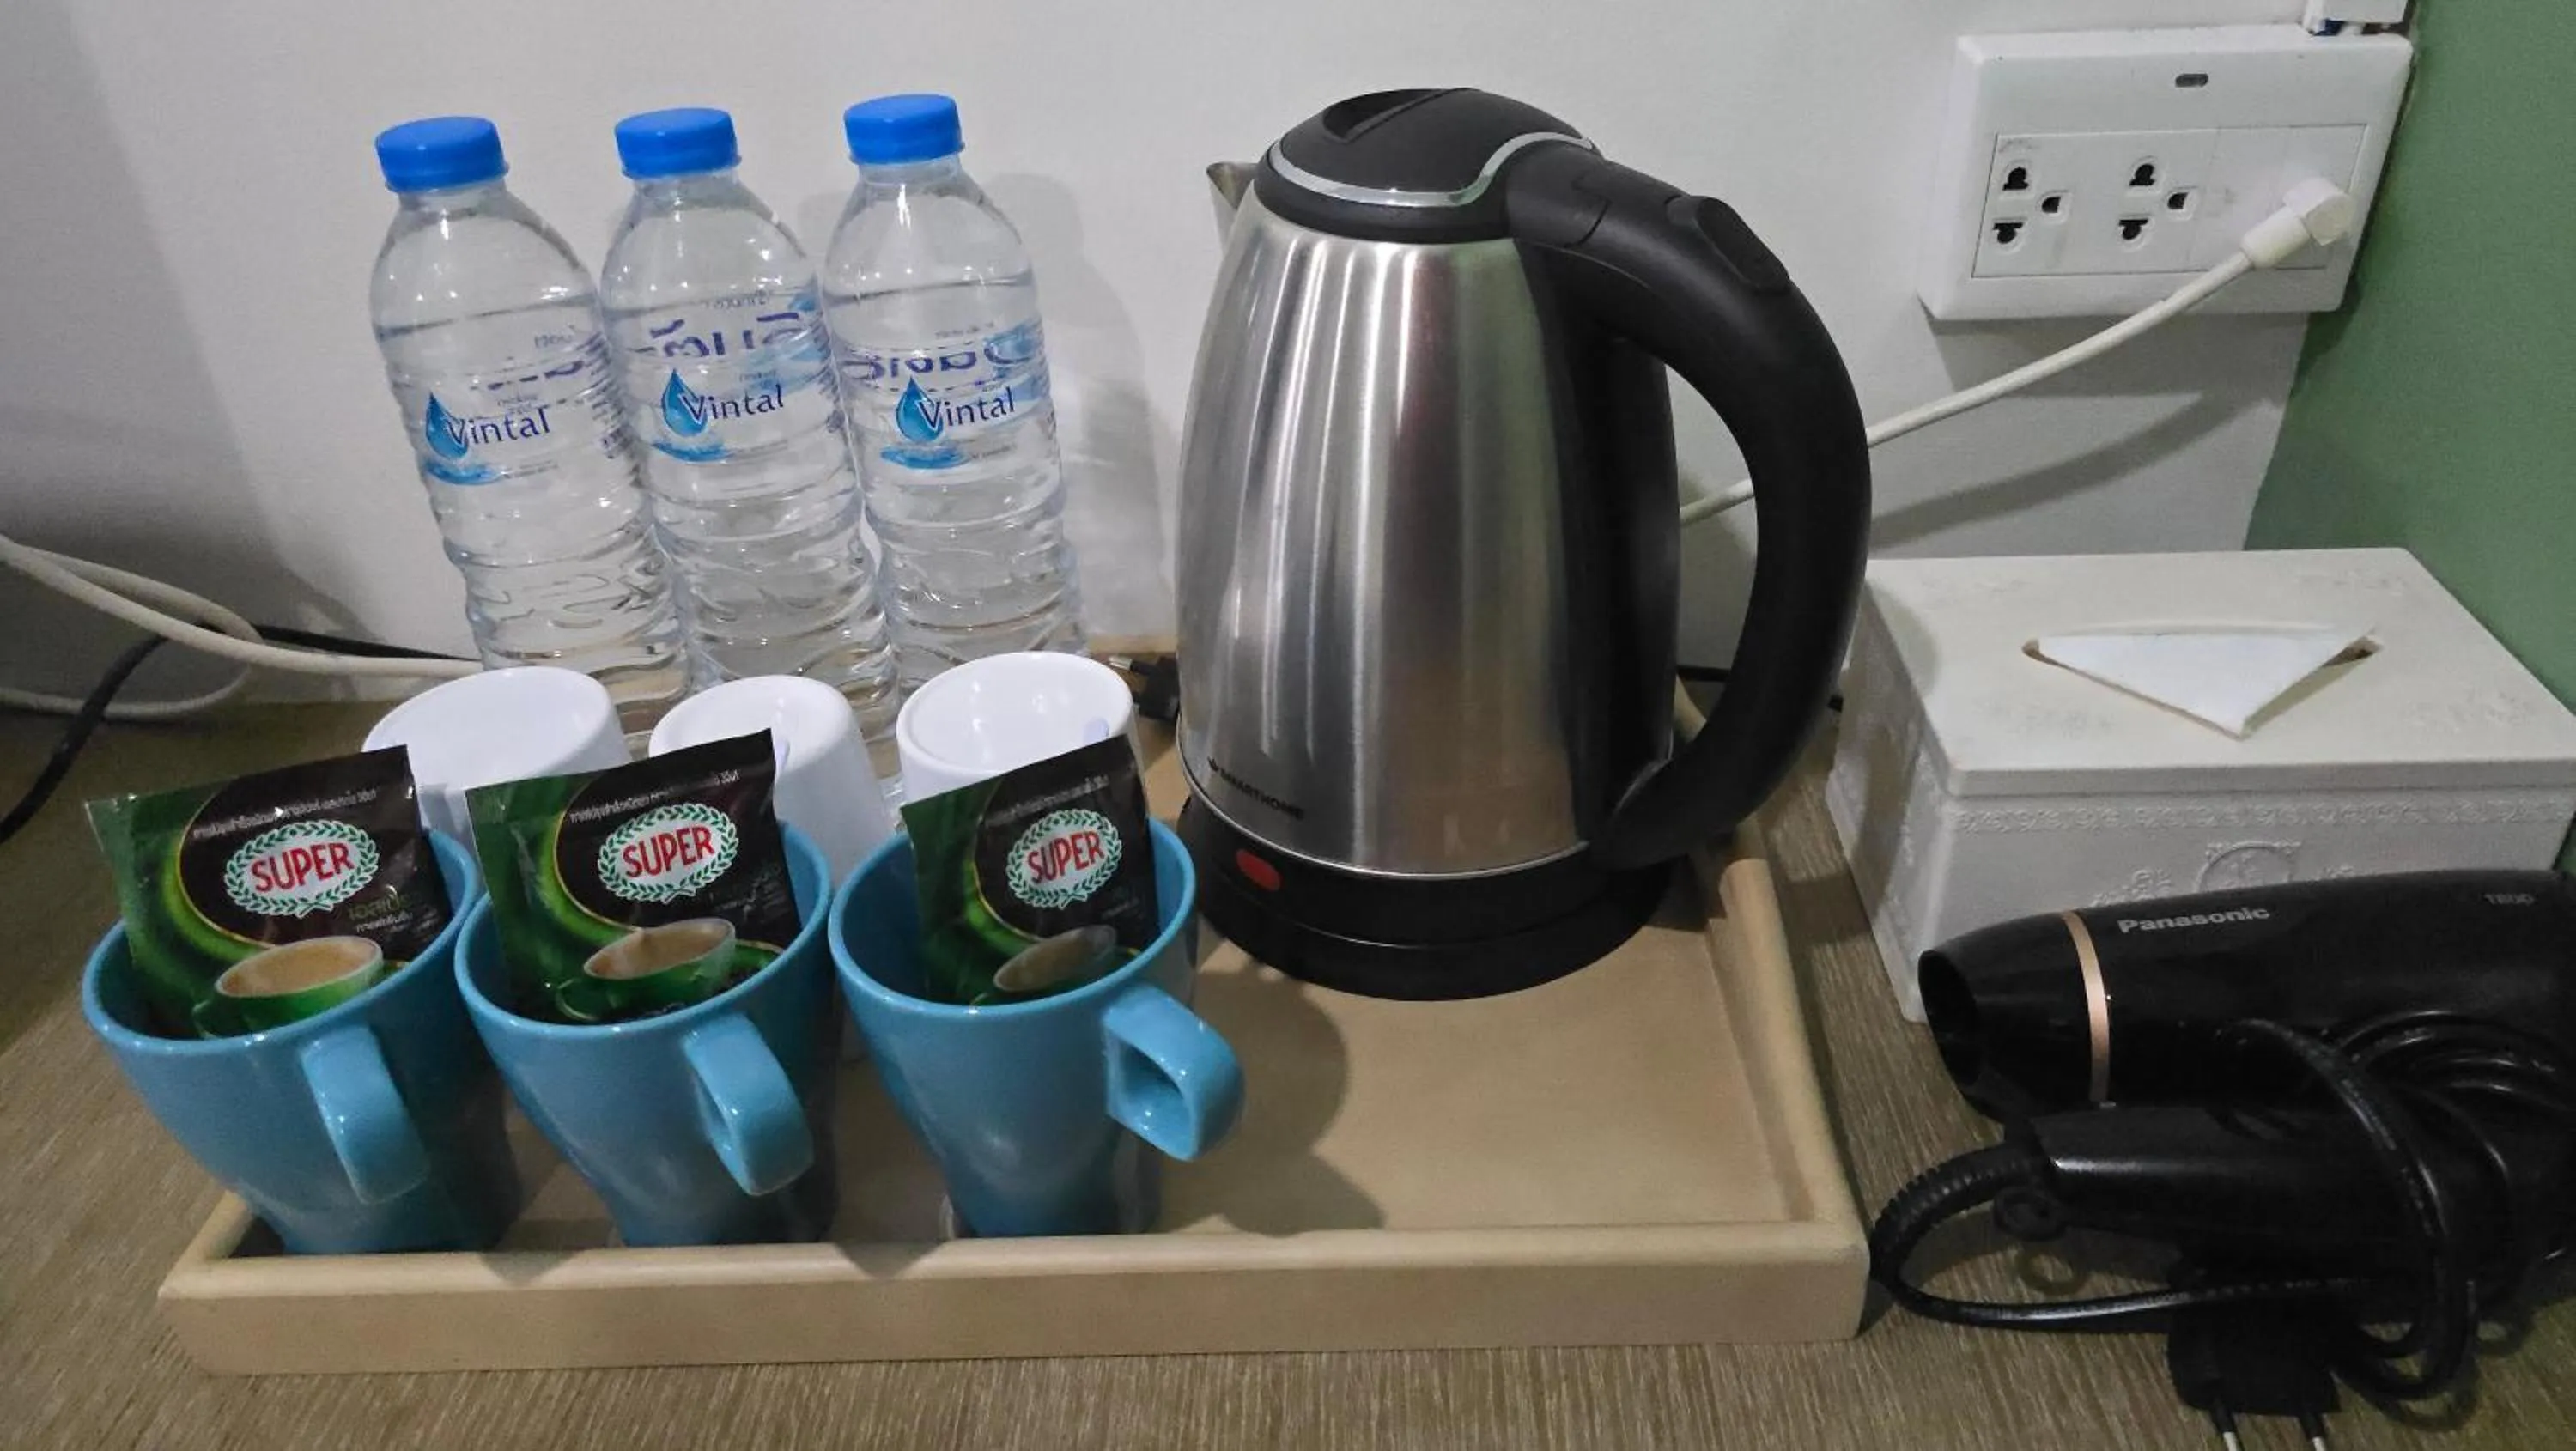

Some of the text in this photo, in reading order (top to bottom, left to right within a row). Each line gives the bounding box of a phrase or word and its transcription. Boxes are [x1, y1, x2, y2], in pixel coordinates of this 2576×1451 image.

[679, 383, 784, 420] Vintal
[918, 386, 1015, 428] Vintal
[446, 408, 550, 445] Vintal
[250, 841, 355, 894] SUPER
[623, 825, 715, 879] SUPER
[1028, 831, 1104, 883] SUPER
[2117, 907, 2270, 934] Panasonic
